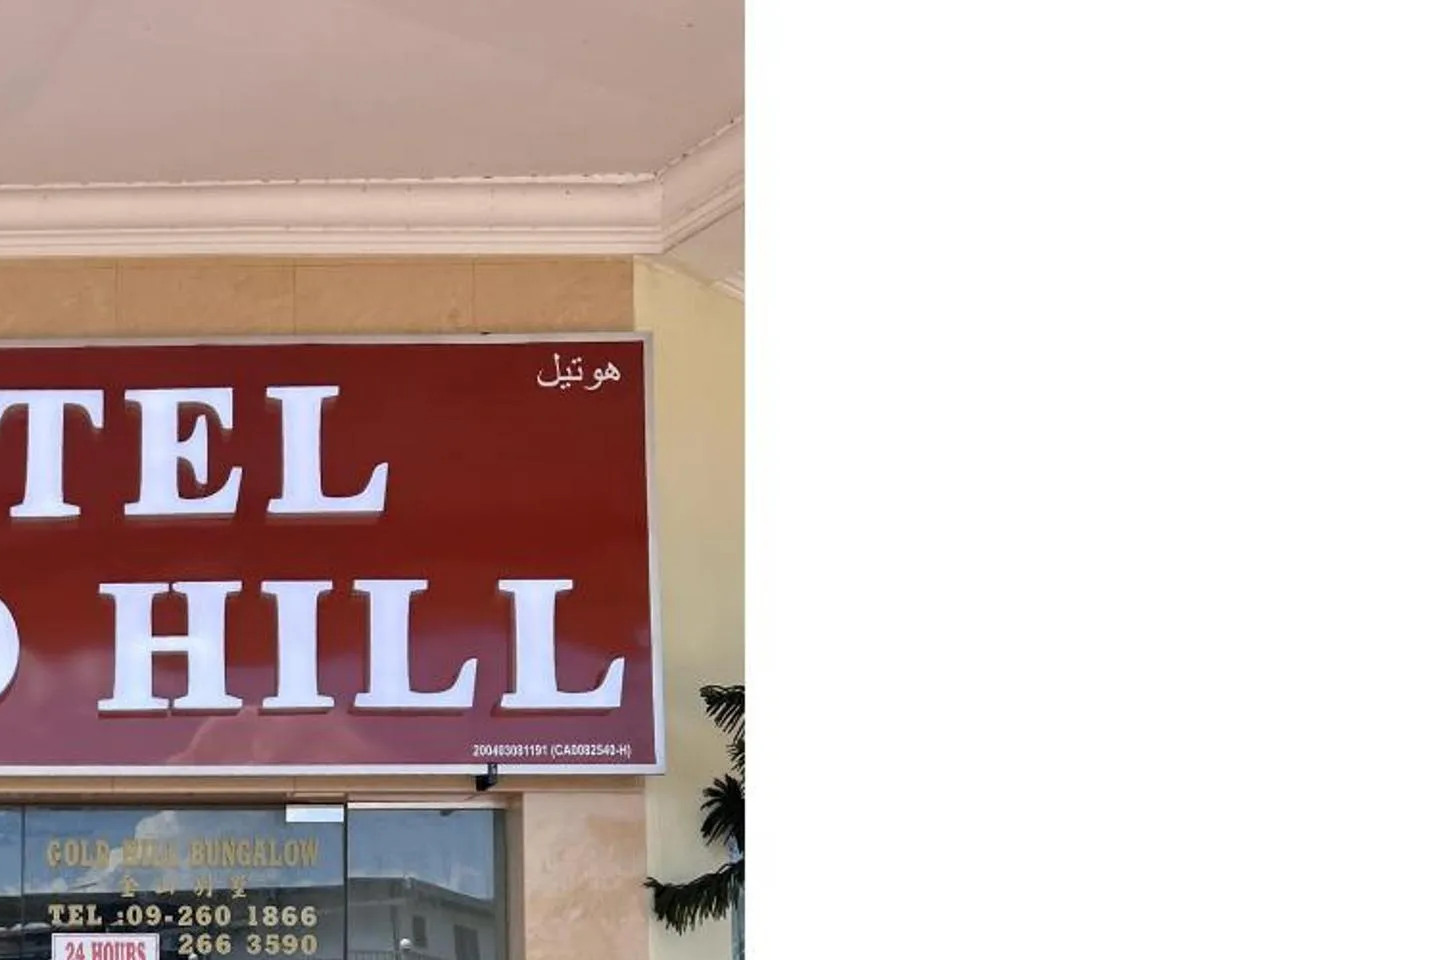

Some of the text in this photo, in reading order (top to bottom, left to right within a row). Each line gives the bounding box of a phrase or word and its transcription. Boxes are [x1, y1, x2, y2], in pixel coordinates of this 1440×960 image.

[537, 353, 620, 390] هوتيل
[97, 578, 626, 710] HILL
[47, 839, 109, 868] GOLD
[188, 837, 320, 869] BUNGALOW
[48, 904, 103, 926] TEL
[247, 905, 318, 927] 1866
[178, 934, 318, 955] 266 3590
